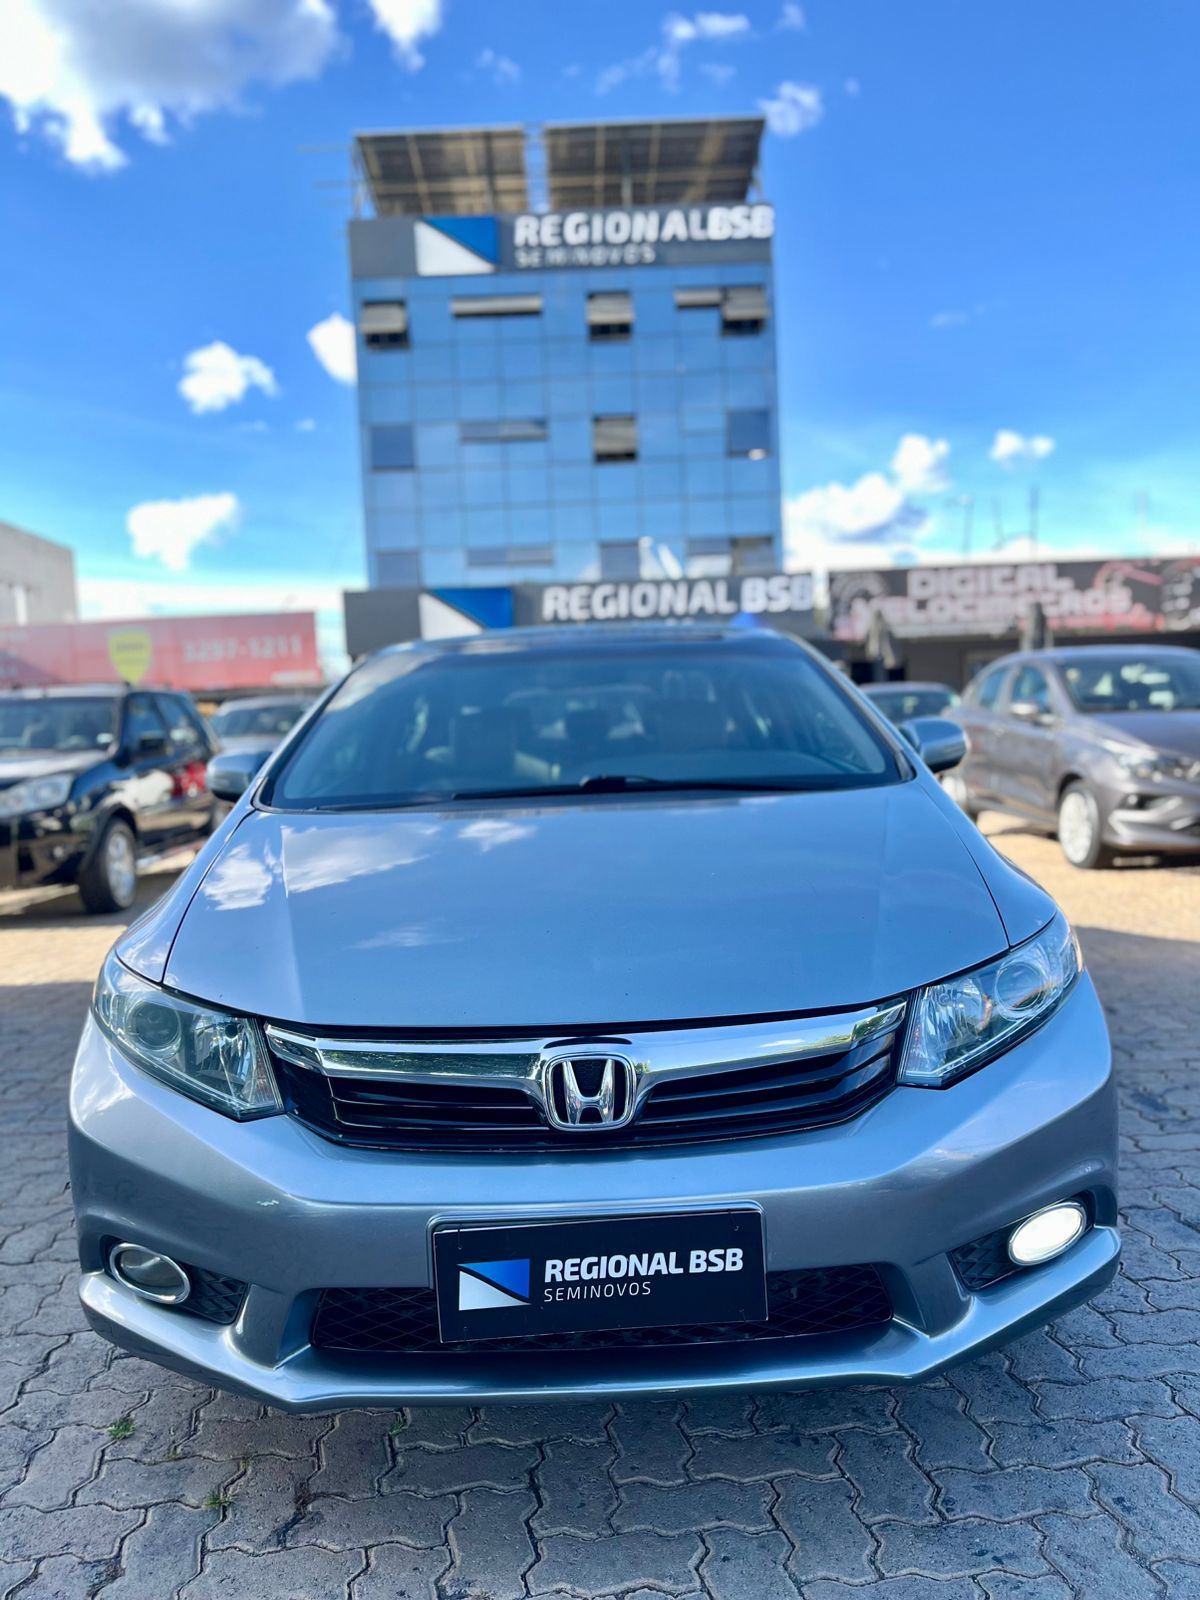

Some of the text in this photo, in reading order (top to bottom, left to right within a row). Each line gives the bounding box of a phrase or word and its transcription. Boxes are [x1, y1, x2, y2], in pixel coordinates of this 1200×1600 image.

[514, 204, 775, 247] REGIONAL BSB
[515, 242, 656, 268] SEMINOVOS
[541, 575, 817, 622] REGIONAL BSB
[544, 1247, 744, 1283] REGIONAL BSB
[543, 1281, 652, 1302] SEMINOVOS
